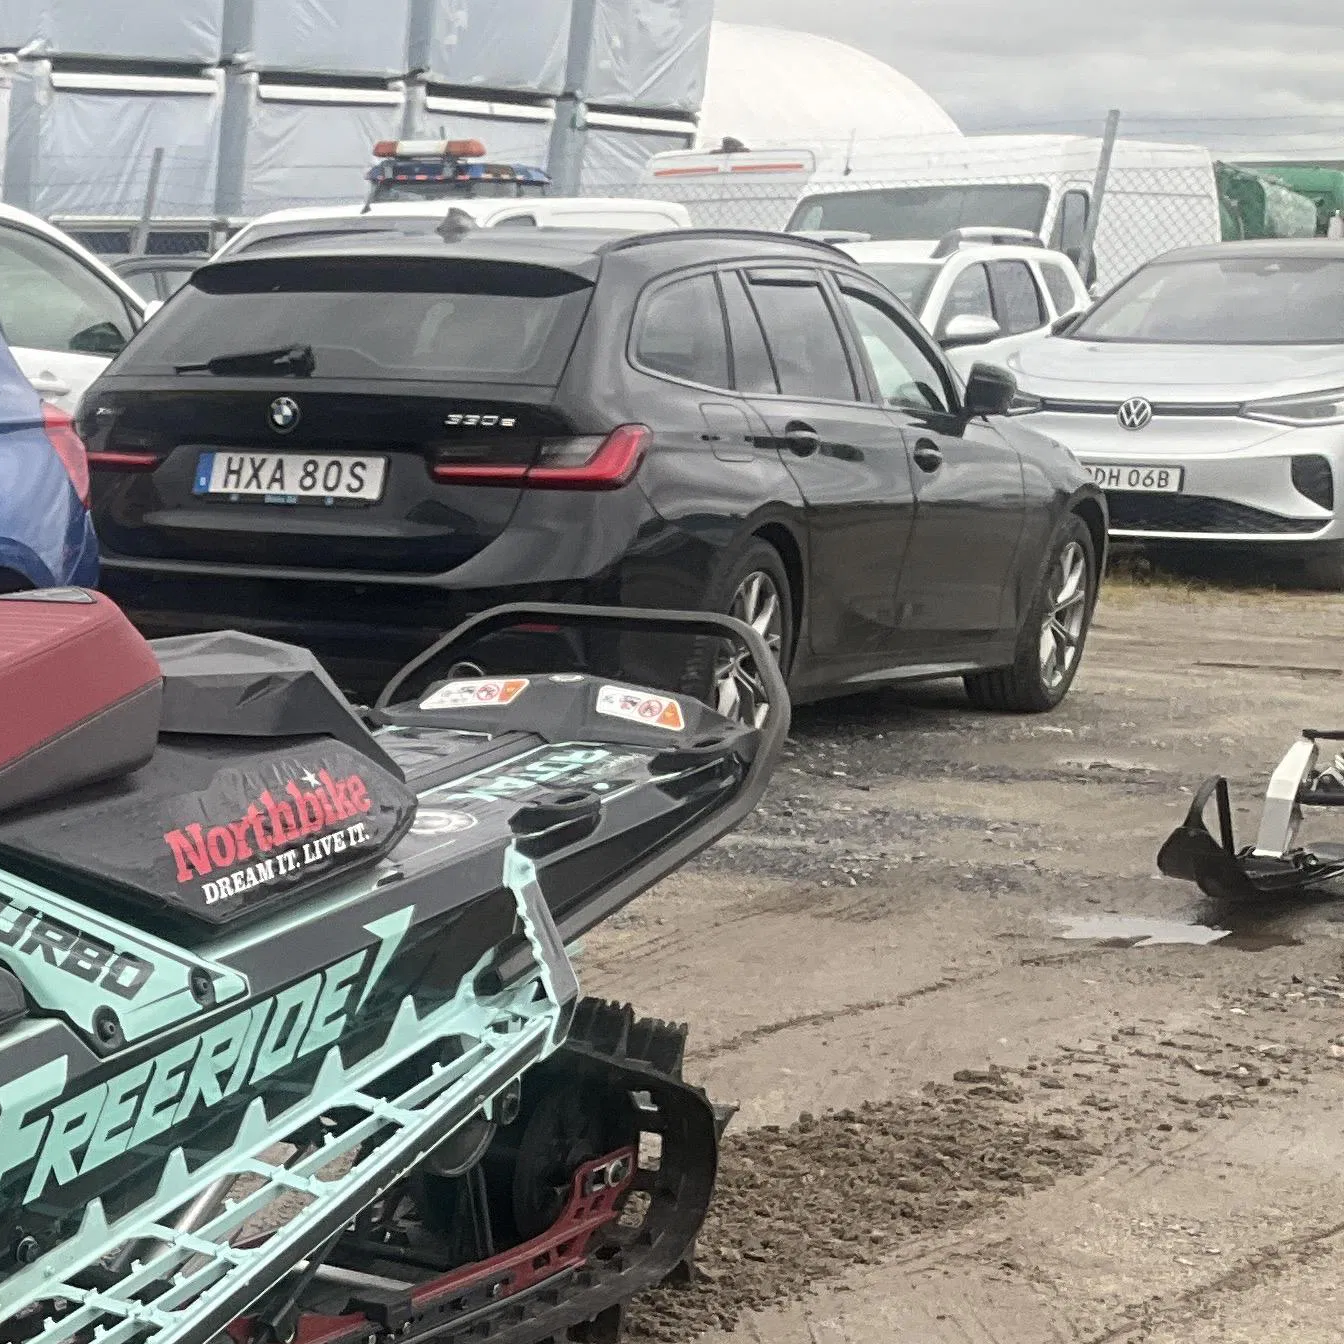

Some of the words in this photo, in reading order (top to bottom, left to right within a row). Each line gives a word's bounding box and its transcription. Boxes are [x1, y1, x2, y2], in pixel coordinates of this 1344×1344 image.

[223, 456, 286, 491] HXA
[299, 459, 367, 493] 80S
[1084, 467, 1120, 487] DH
[1128, 469, 1169, 488] 06B
[164, 768, 373, 883] Northbike
[201, 858, 276, 905] DREAM
[276, 848, 302, 876] IT.
[302, 830, 347, 864] LIVE
[347, 822, 370, 844] IT.
